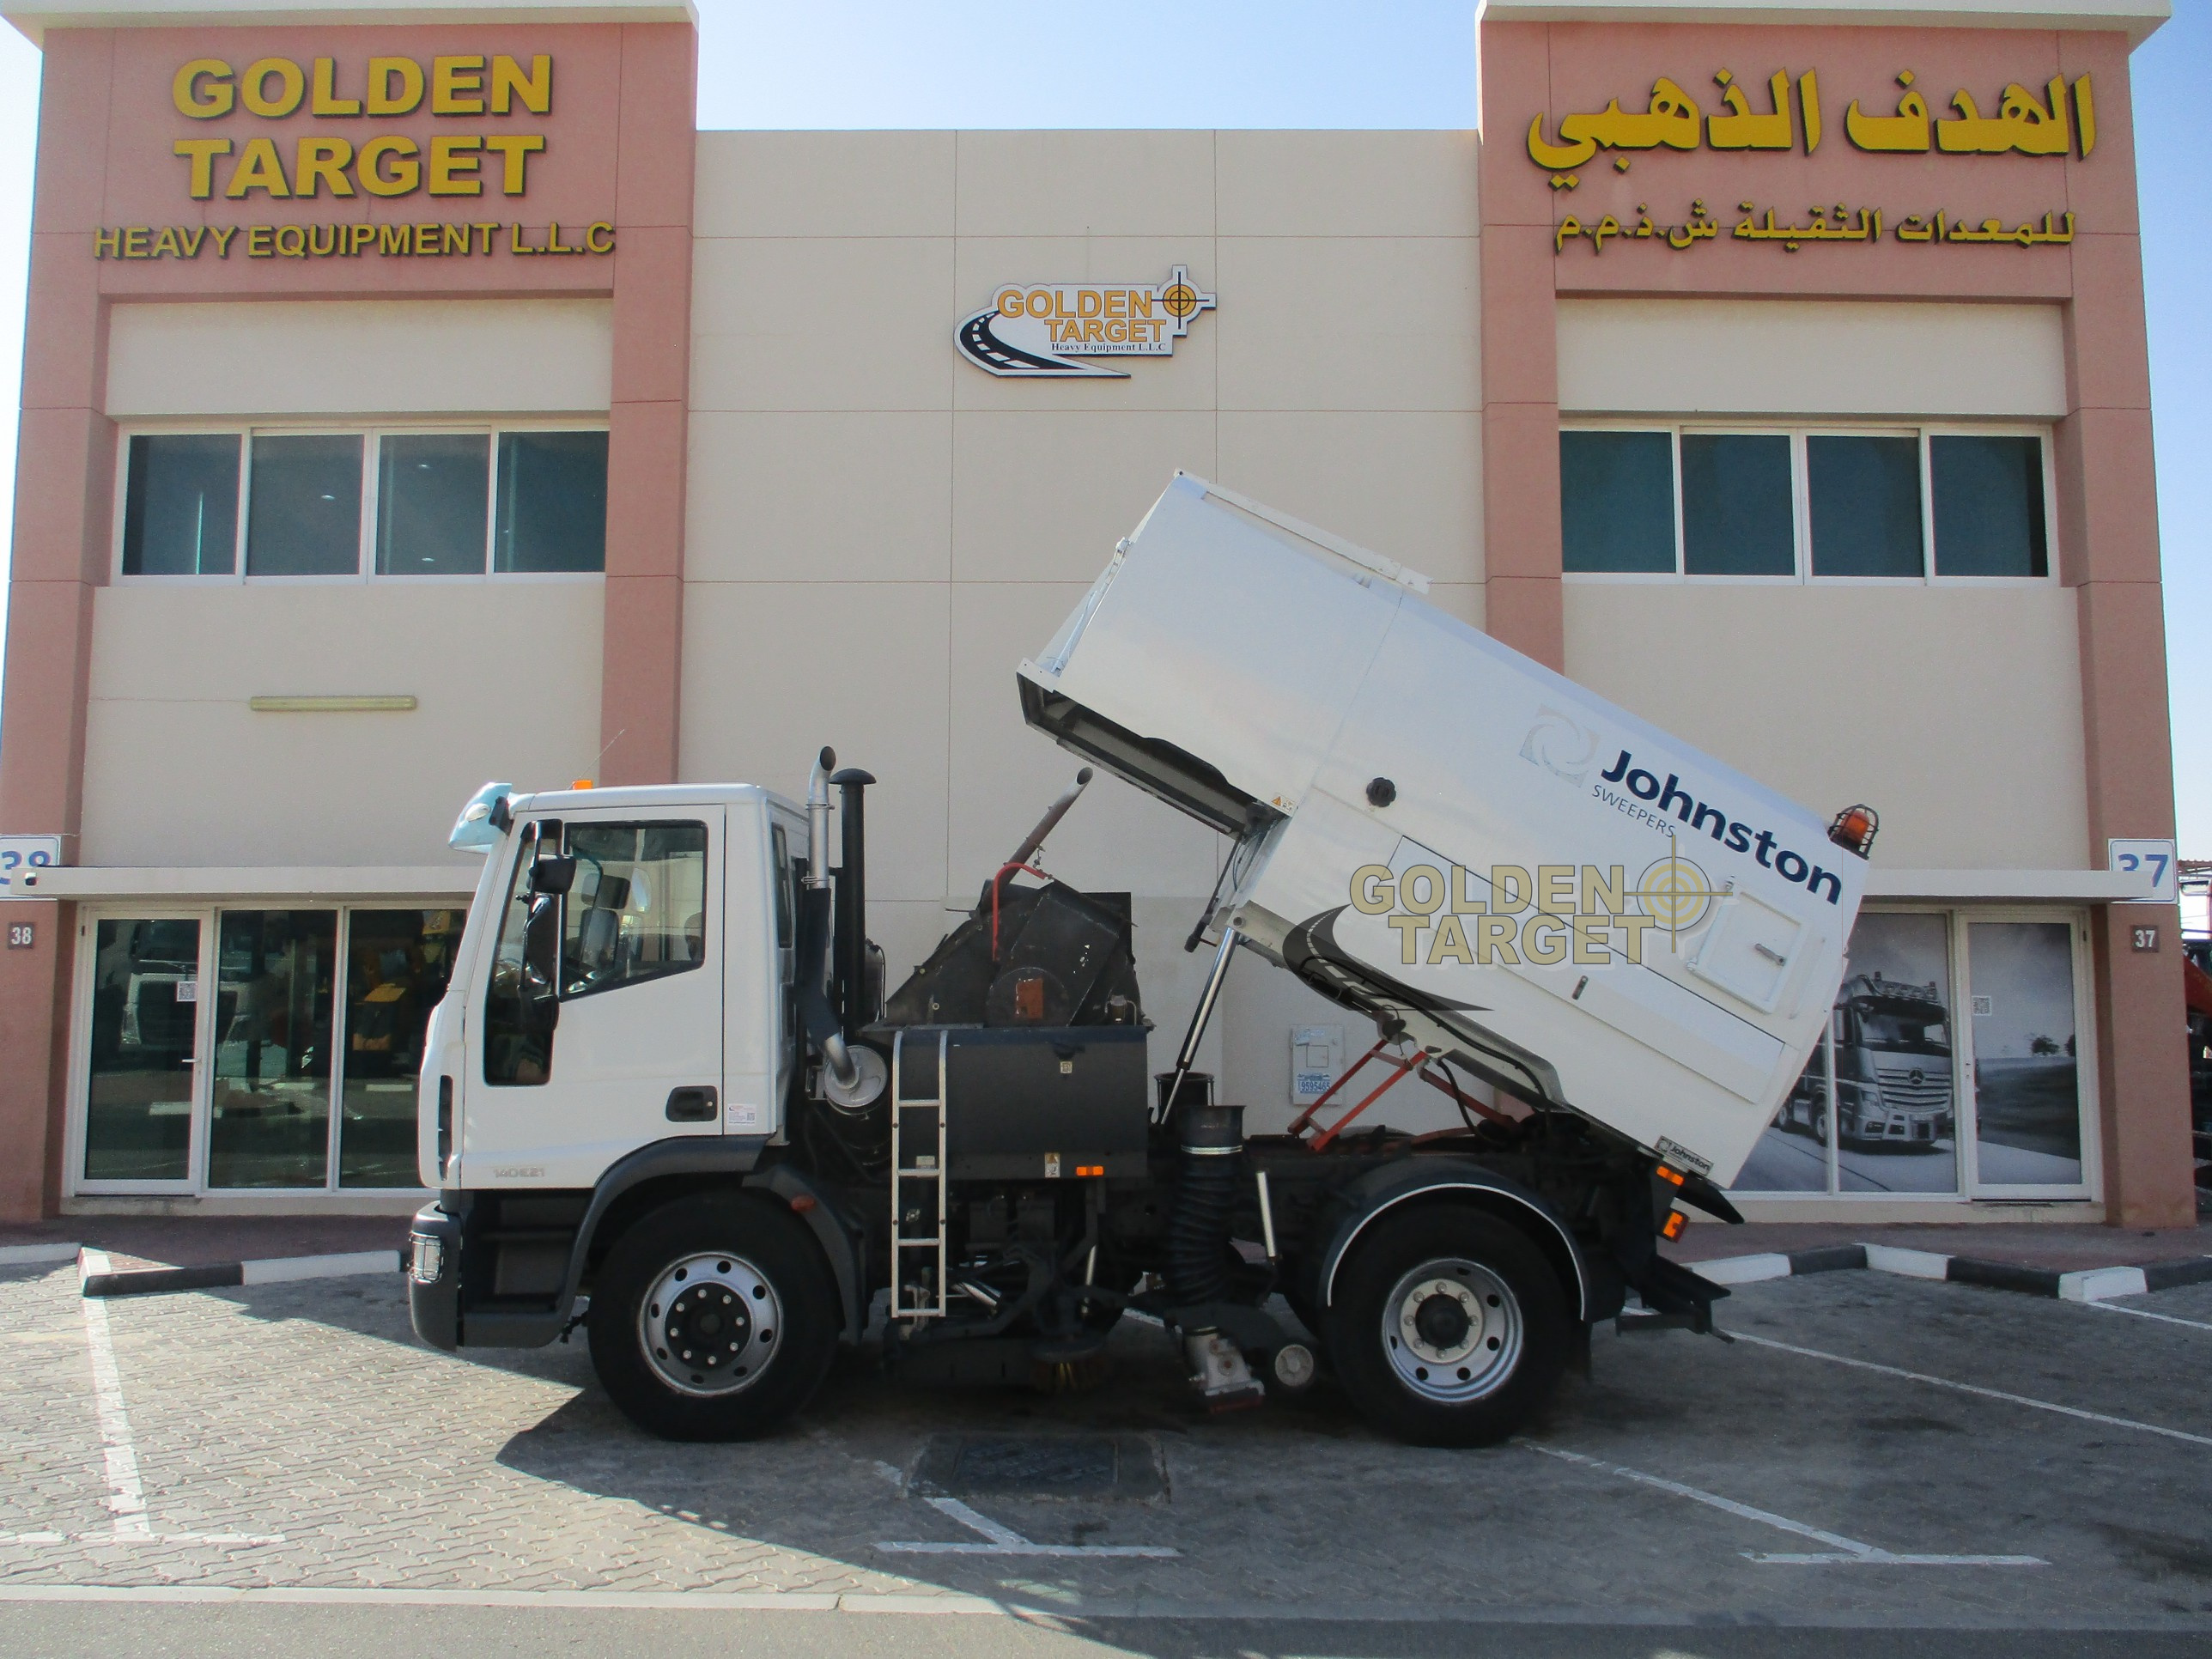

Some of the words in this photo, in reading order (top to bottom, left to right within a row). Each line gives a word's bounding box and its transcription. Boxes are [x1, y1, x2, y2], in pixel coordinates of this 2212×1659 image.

[173, 54, 552, 118] GOLDEN
[1527, 67, 1822, 191] الذهبي
[1843, 69, 2096, 161] الهدف
[173, 135, 545, 200] TARGET
[94, 225, 239, 258] HEAVY
[247, 222, 498, 258] EQUIPMENT
[511, 222, 617, 256] L.L.C
[1732, 201, 1883, 252] الثقيلة
[1895, 210, 2075, 246] للمعدات
[997, 290, 1152, 319] GOLDEN
[1044, 319, 1167, 343] TARGET
[1051, 343, 1080, 353] Heavy
[1084, 343, 1135, 353] Equipment
[1139, 343, 1166, 351] L.L.C
[1592, 784, 1675, 838] SWEEPERS
[1601, 750, 1843, 905] Johnston
[11, 927, 33, 945] 38
[2135, 929, 2156, 948] 37
[1670, 1146, 1711, 1171] Johnston
